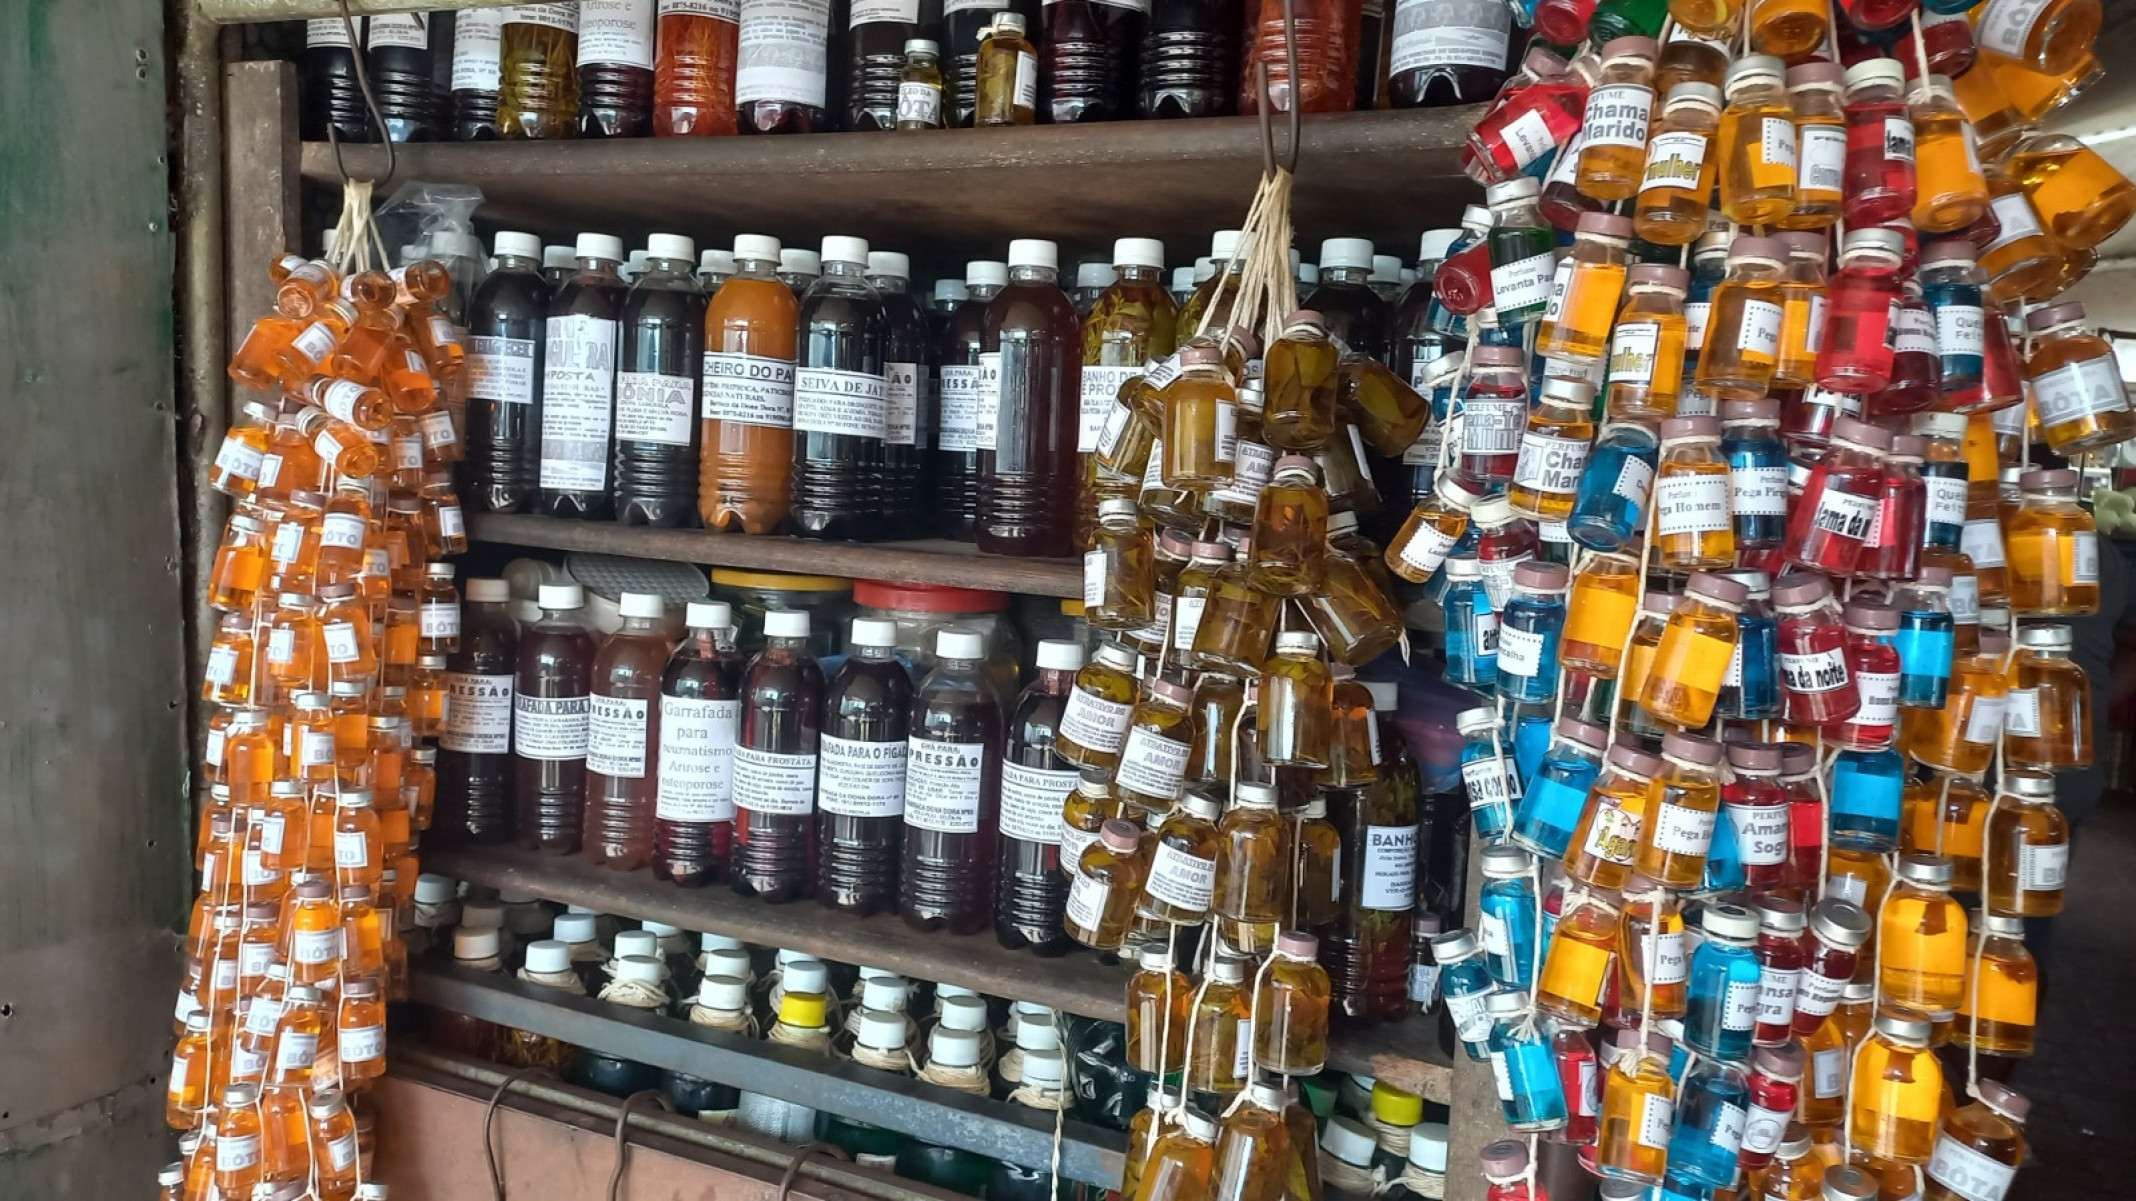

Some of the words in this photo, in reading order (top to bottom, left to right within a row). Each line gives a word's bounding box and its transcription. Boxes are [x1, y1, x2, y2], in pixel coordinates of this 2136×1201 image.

[1496, 277, 1535, 296] Levanta
[750, 364, 771, 379] DO
[801, 376, 839, 391] SEIVA
[844, 381, 863, 393] DE
[664, 701, 733, 719] Garrafada
[677, 727, 708, 741] para
[873, 747, 881, 759] O
